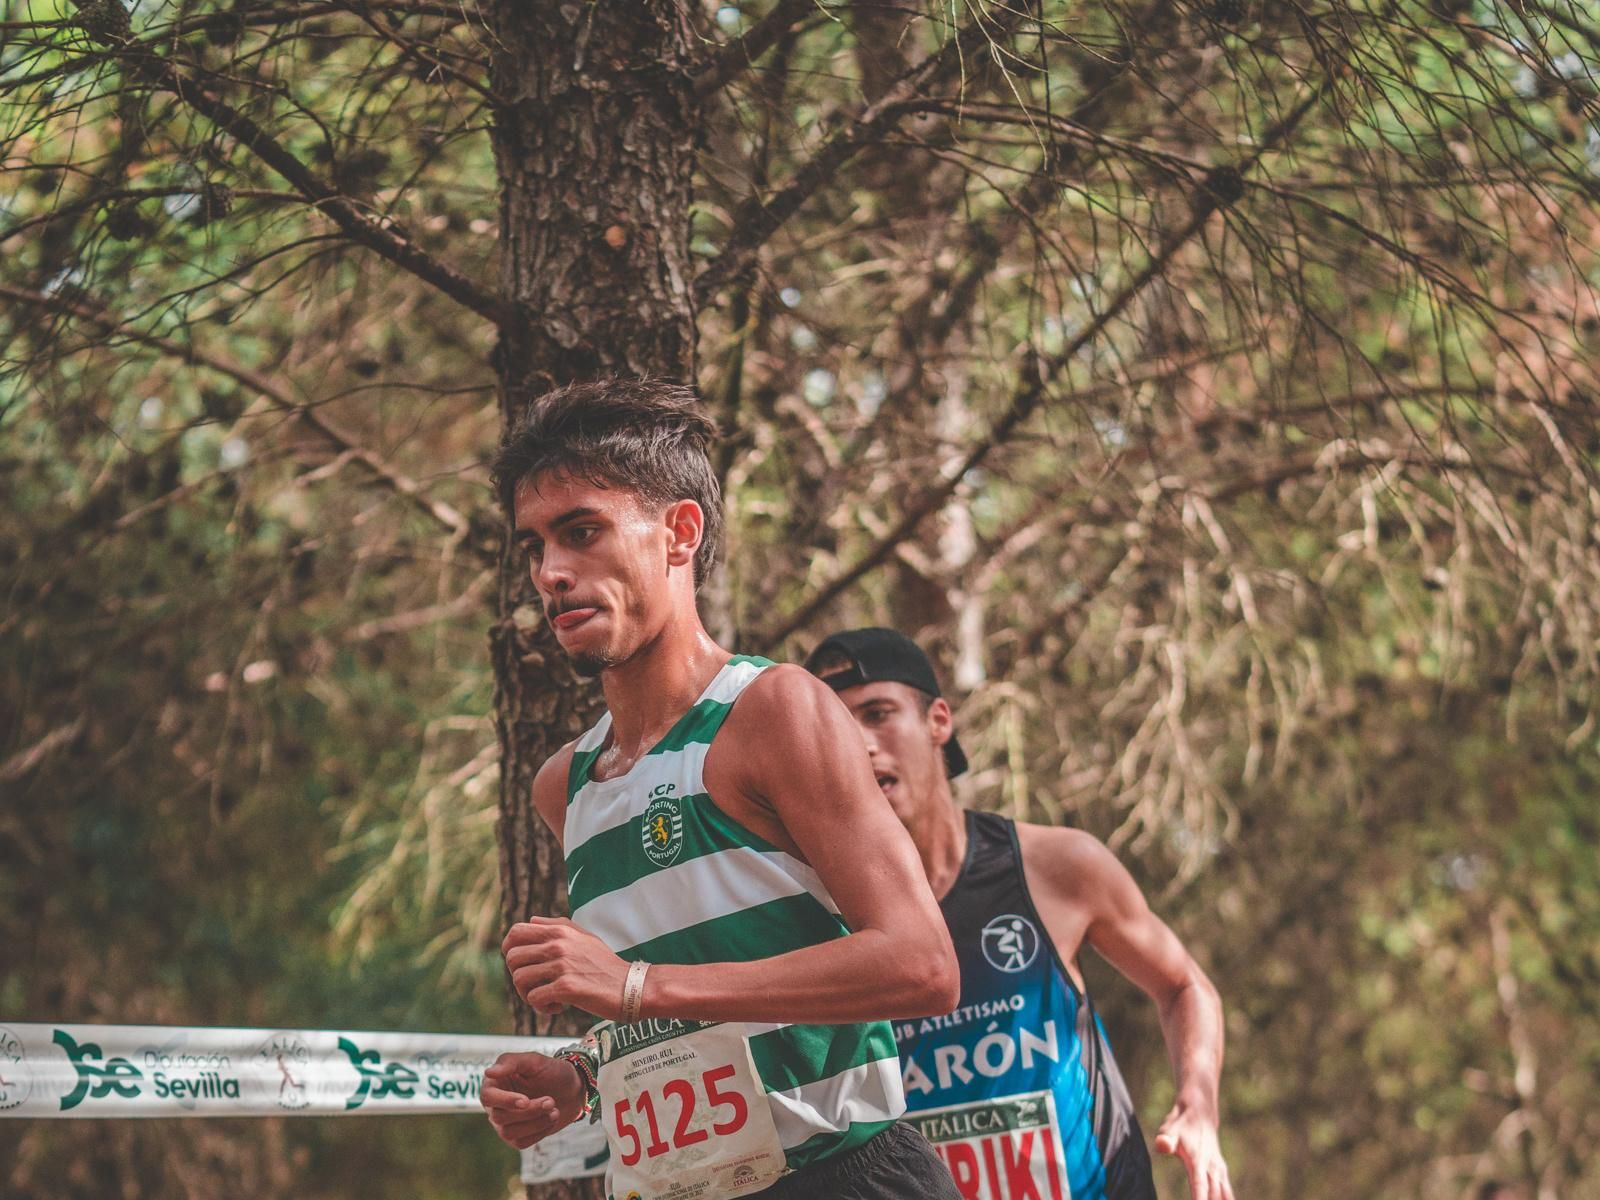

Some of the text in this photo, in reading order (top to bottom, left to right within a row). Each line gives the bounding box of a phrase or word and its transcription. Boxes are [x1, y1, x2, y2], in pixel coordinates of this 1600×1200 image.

[645, 801, 678, 823] ORTING
[920, 994, 1025, 1034] ATLETISMO
[154, 1072, 240, 1098] Sevilla
[614, 1064, 748, 1167] 5125
